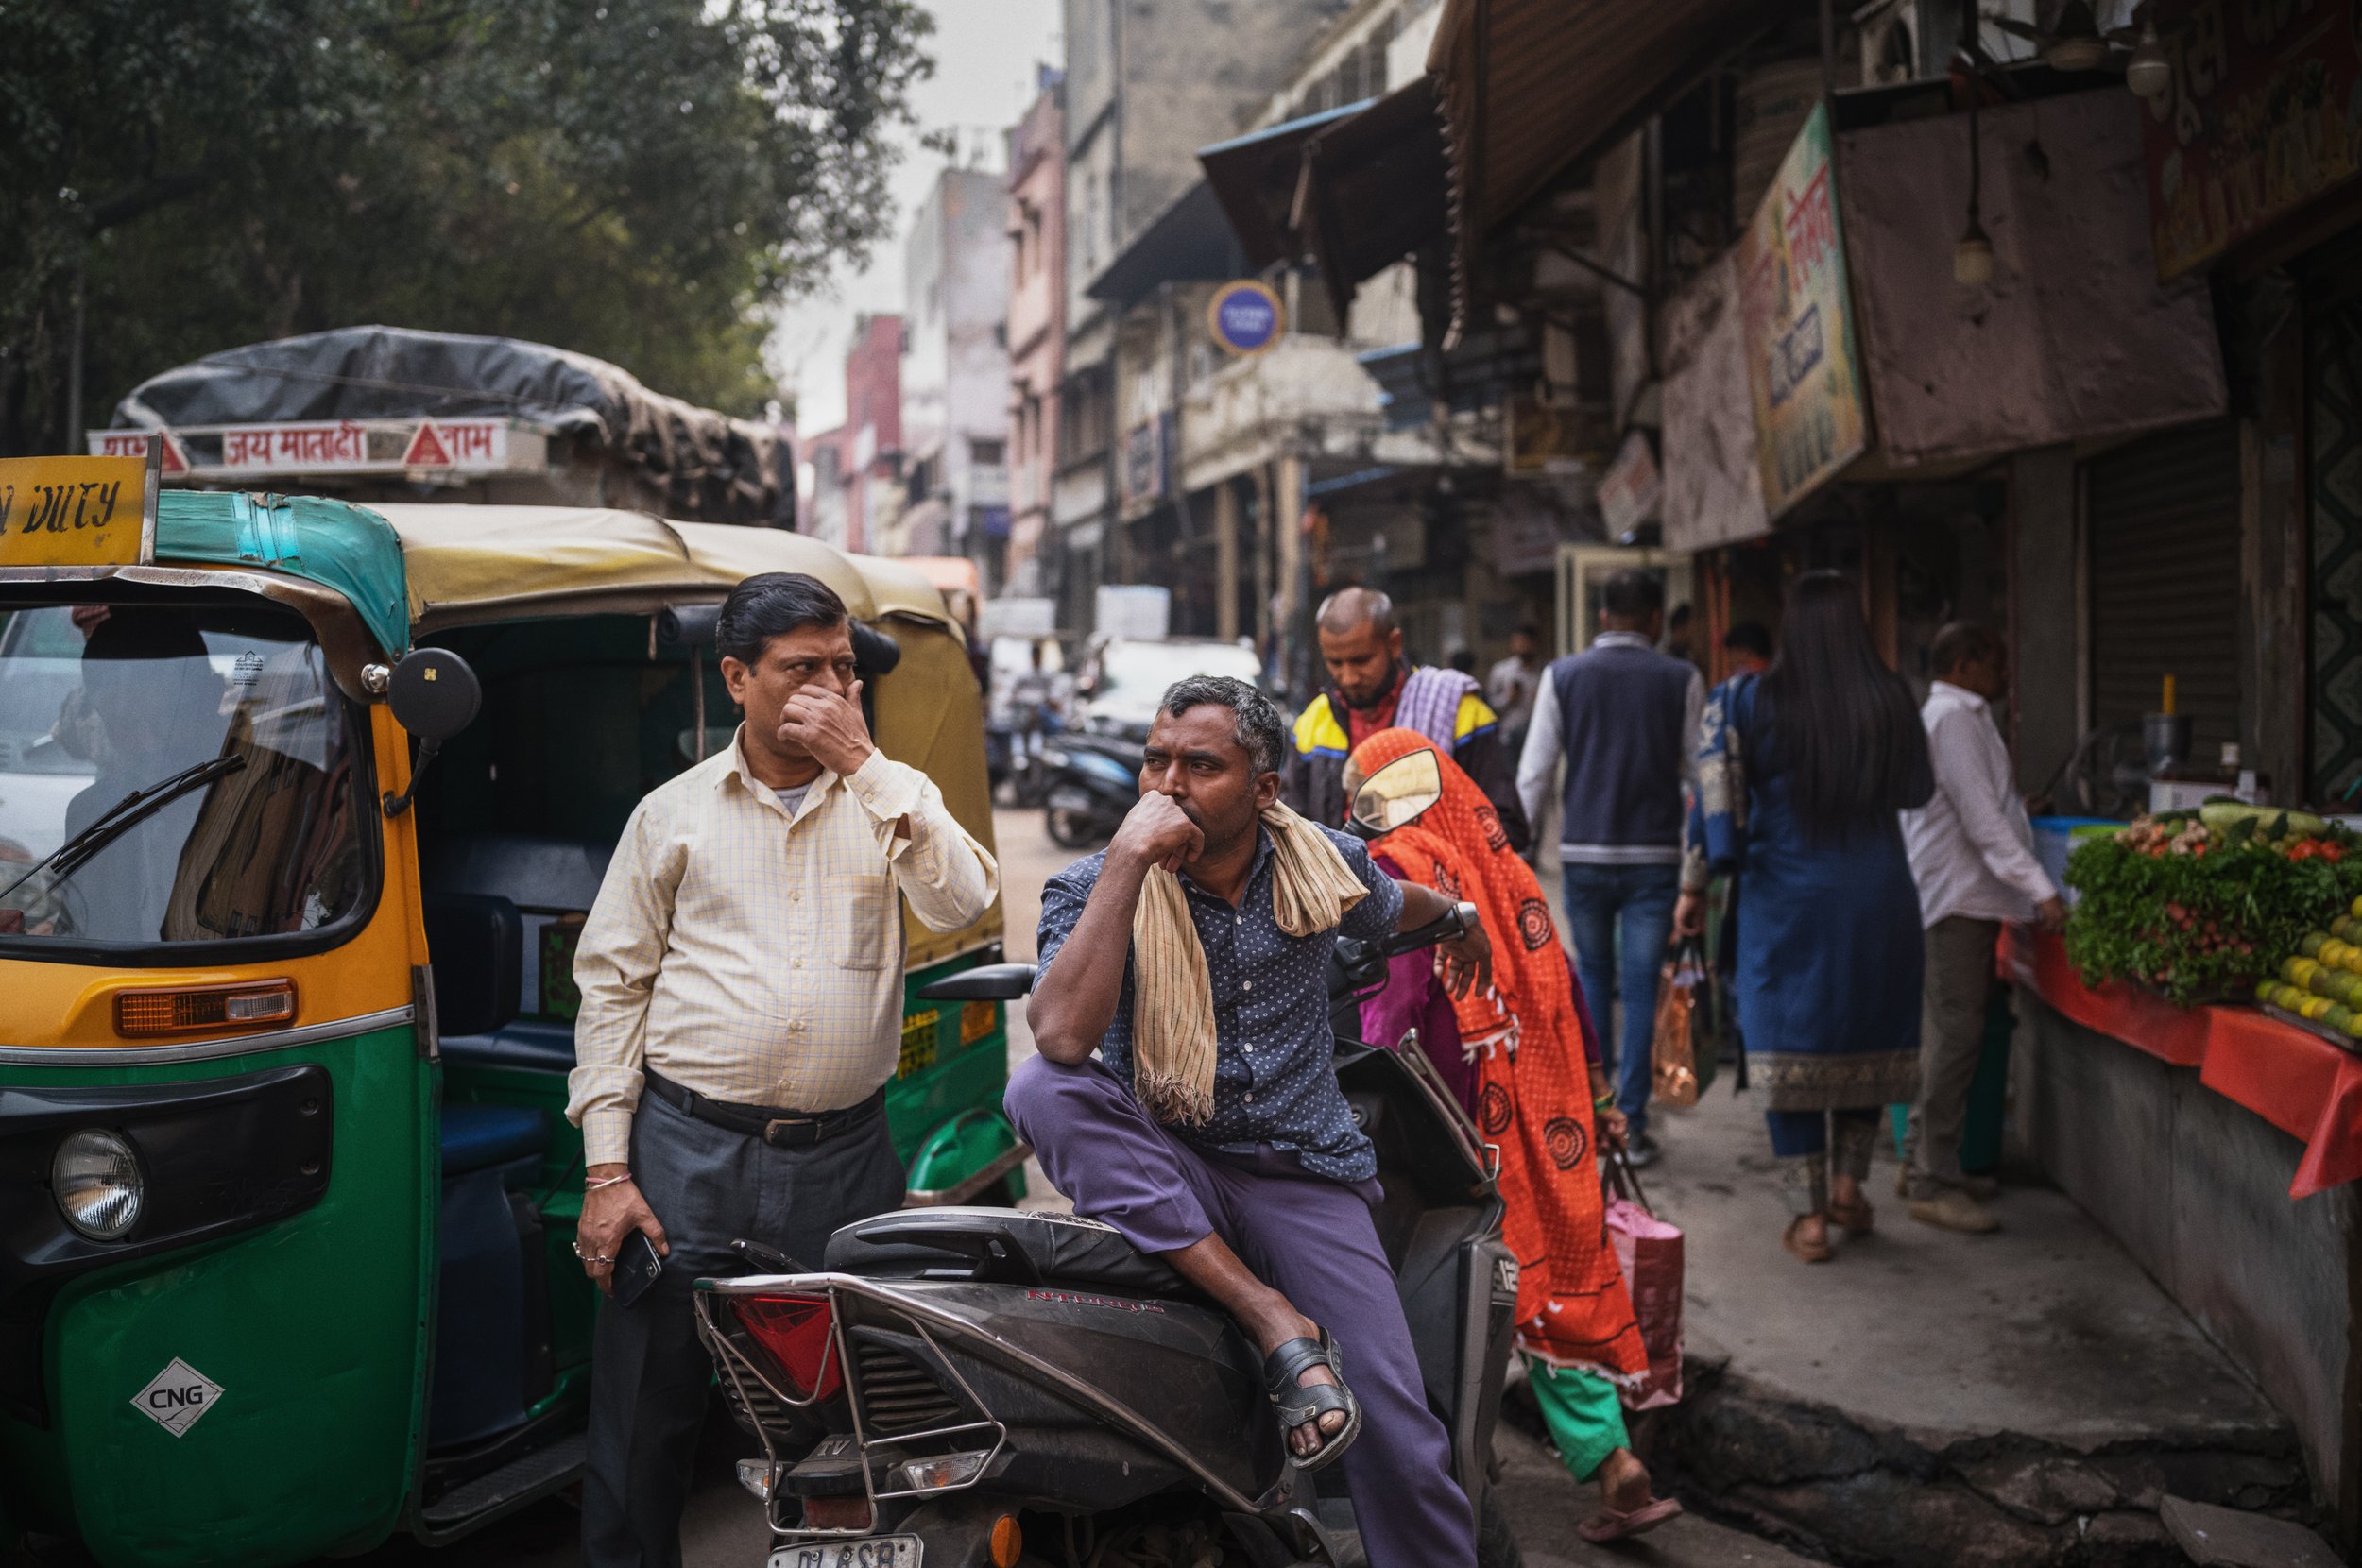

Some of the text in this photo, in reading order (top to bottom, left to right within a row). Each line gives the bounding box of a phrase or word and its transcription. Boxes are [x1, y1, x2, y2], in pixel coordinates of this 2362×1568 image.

[228, 431, 272, 465] जय
[22, 481, 121, 534] DUTY
[149, 1385, 203, 1409] CNG
